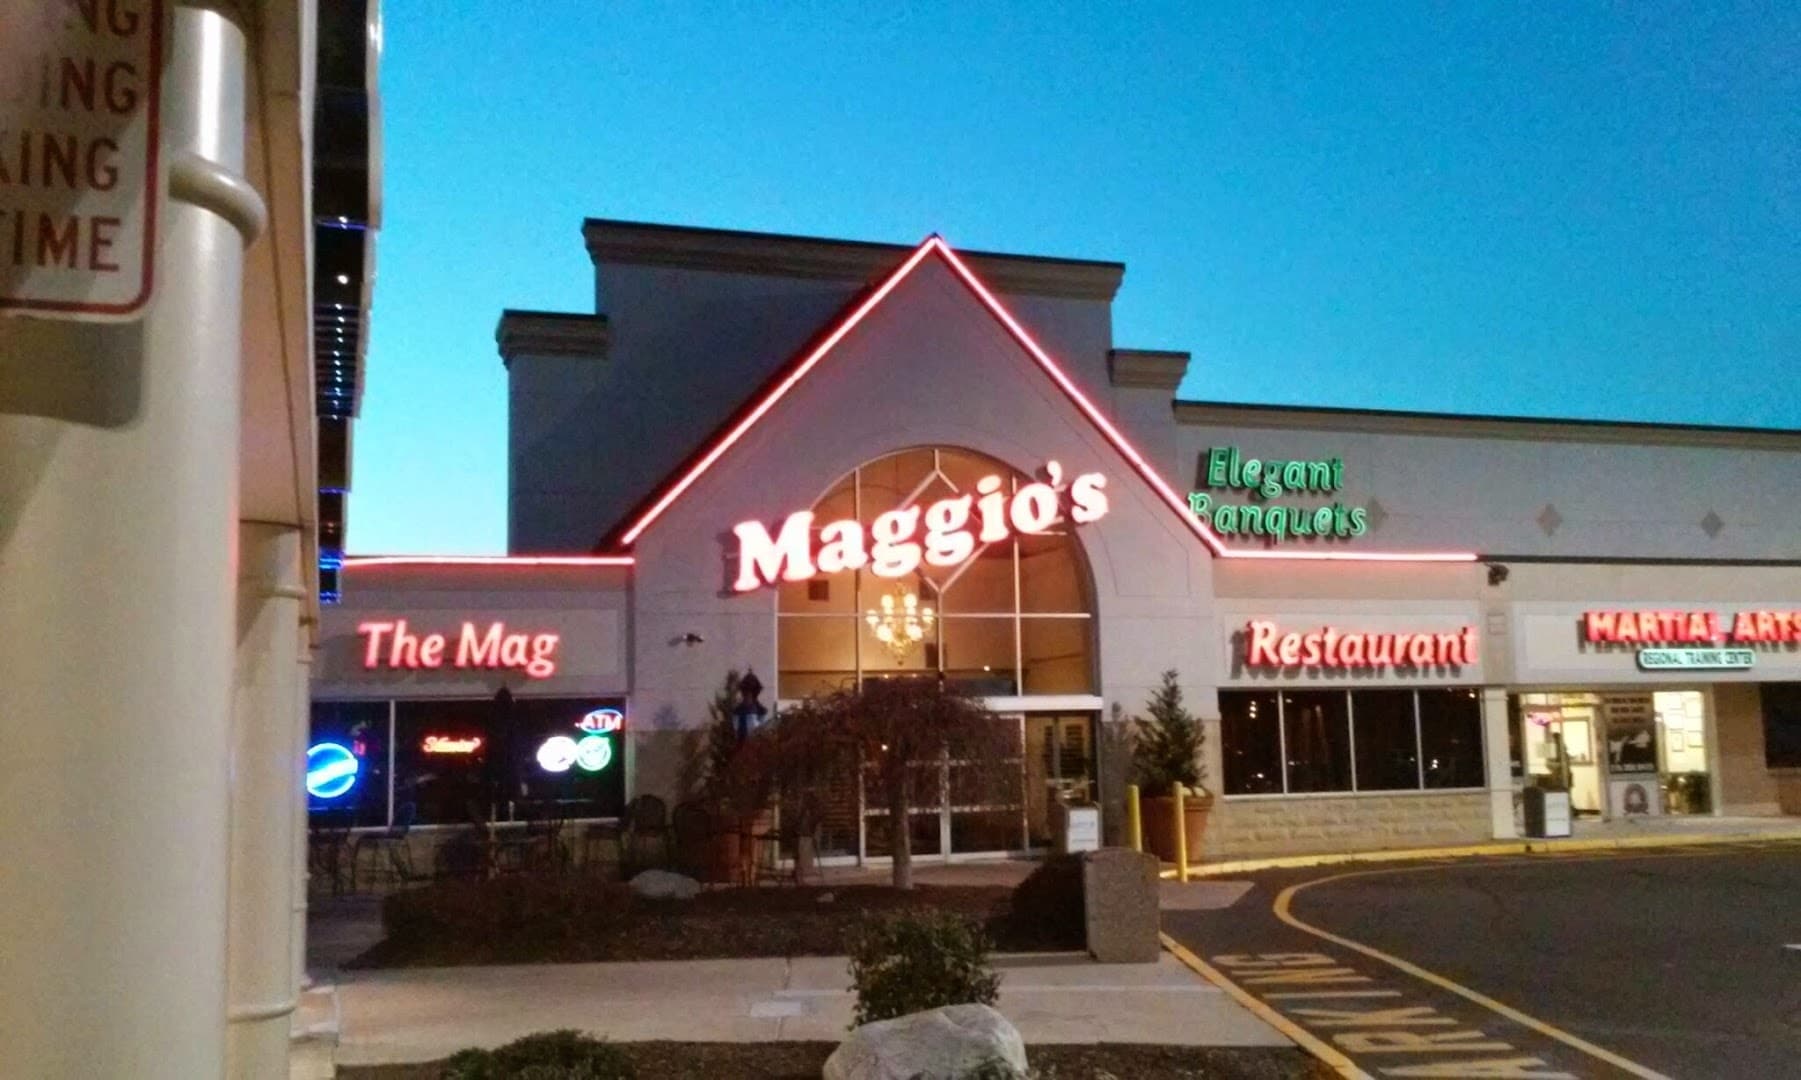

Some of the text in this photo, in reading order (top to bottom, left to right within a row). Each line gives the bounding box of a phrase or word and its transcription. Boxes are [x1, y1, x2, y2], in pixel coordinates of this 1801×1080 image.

[1207, 447, 1345, 499] Elegant
[732, 459, 1110, 592] Maggio's
[1188, 492, 1368, 541] Banquets
[357, 619, 560, 679] The Mag
[1248, 619, 1480, 667] Restaurant
[1584, 612, 1727, 643] MARTIAL
[581, 711, 622, 731] ATM
